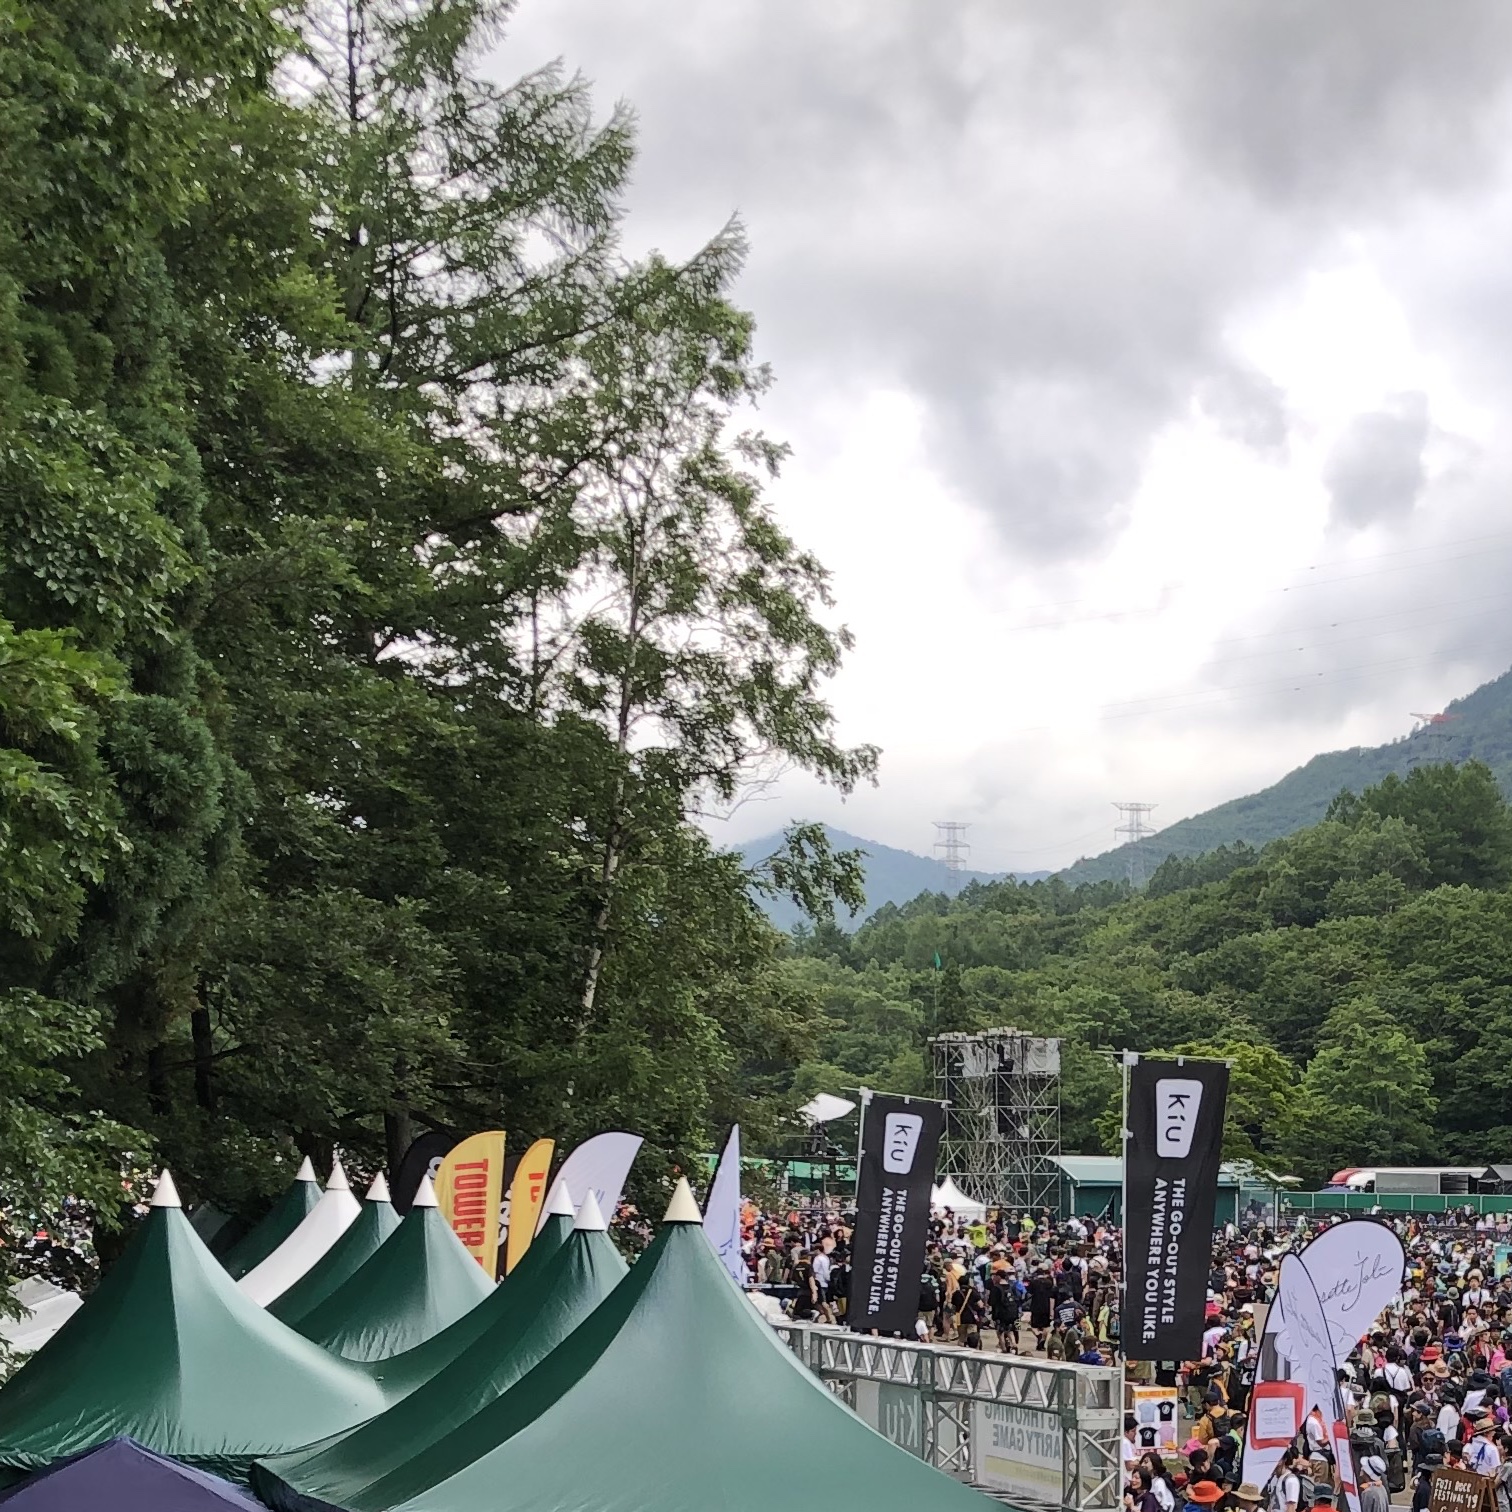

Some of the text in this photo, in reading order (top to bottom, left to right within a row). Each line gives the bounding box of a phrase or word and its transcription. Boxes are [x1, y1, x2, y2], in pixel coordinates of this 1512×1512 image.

[452, 1158, 489, 1247] TOWER
[867, 1186, 895, 1316] ANYWHERE YOU LIKE.
[884, 1189, 908, 1302] THE GO-OUT STYLE
[1161, 1178, 1186, 1324] THE GO-OUT STYLE
[1142, 1177, 1168, 1345] ANYWHERE YOU LIKE.
[1433, 1489, 1464, 1504] FESTIVAL
[1436, 1478, 1472, 1493] FUJI ROCK
